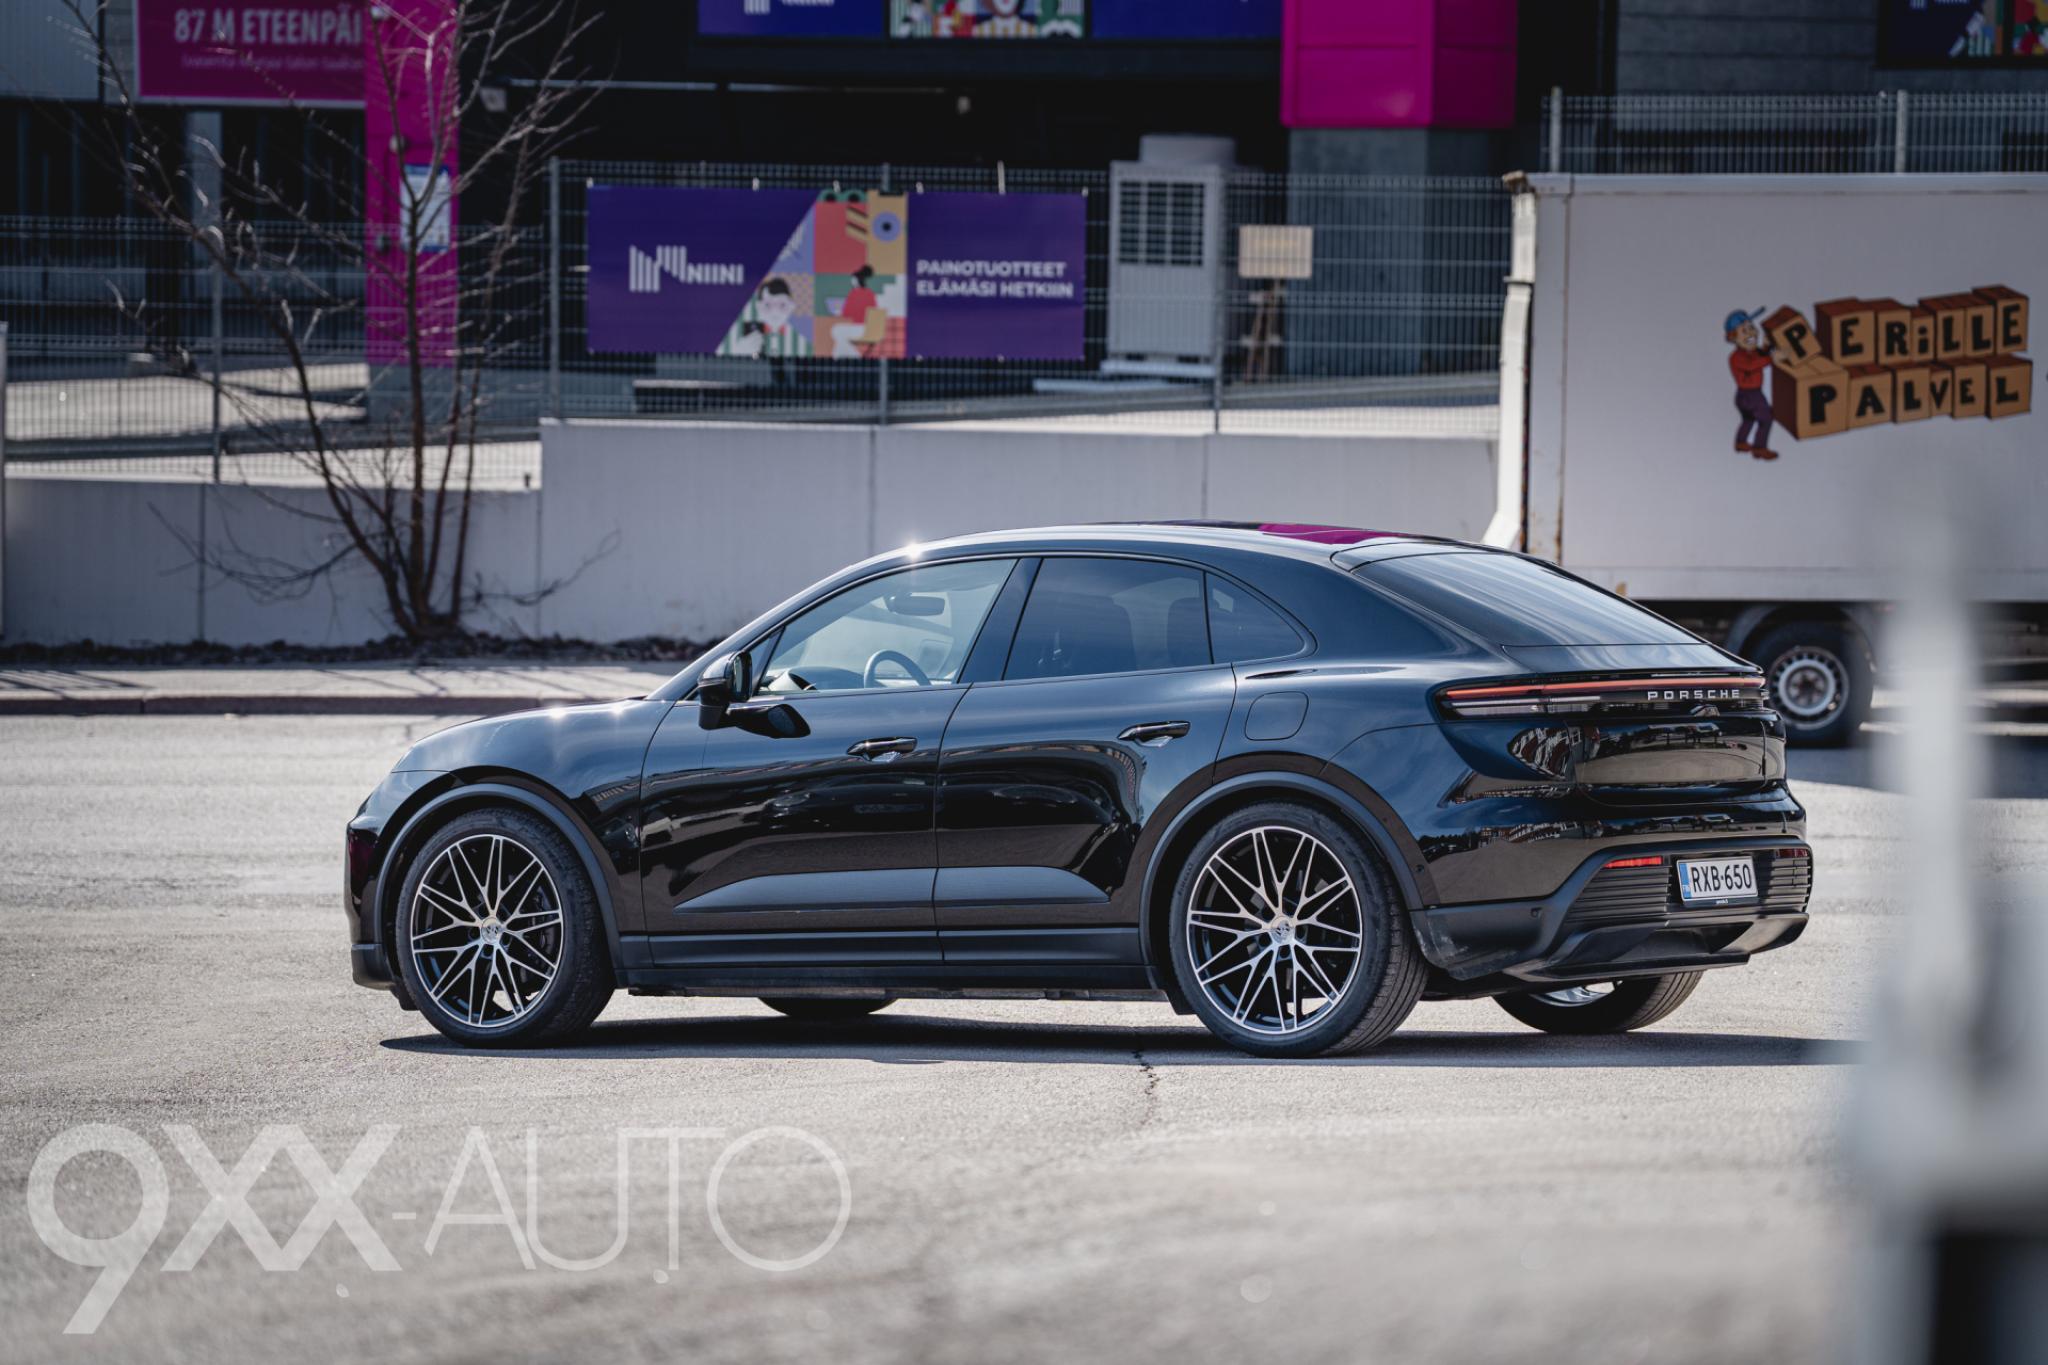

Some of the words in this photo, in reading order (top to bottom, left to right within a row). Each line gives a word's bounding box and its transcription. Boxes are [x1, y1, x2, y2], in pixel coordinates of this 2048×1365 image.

[174, 8, 206, 42] 87
[211, 9, 235, 44] M
[687, 262, 745, 285] NIINI
[916, 259, 1067, 278] PAINOTUOTTEET
[916, 277, 997, 297] ELÄMÄSI
[1000, 281, 1074, 298] HETKIIN
[1808, 376, 2019, 426] PALVEL
[1647, 689, 1740, 701] PORSCHE
[1691, 863, 1752, 893] RXB-650
